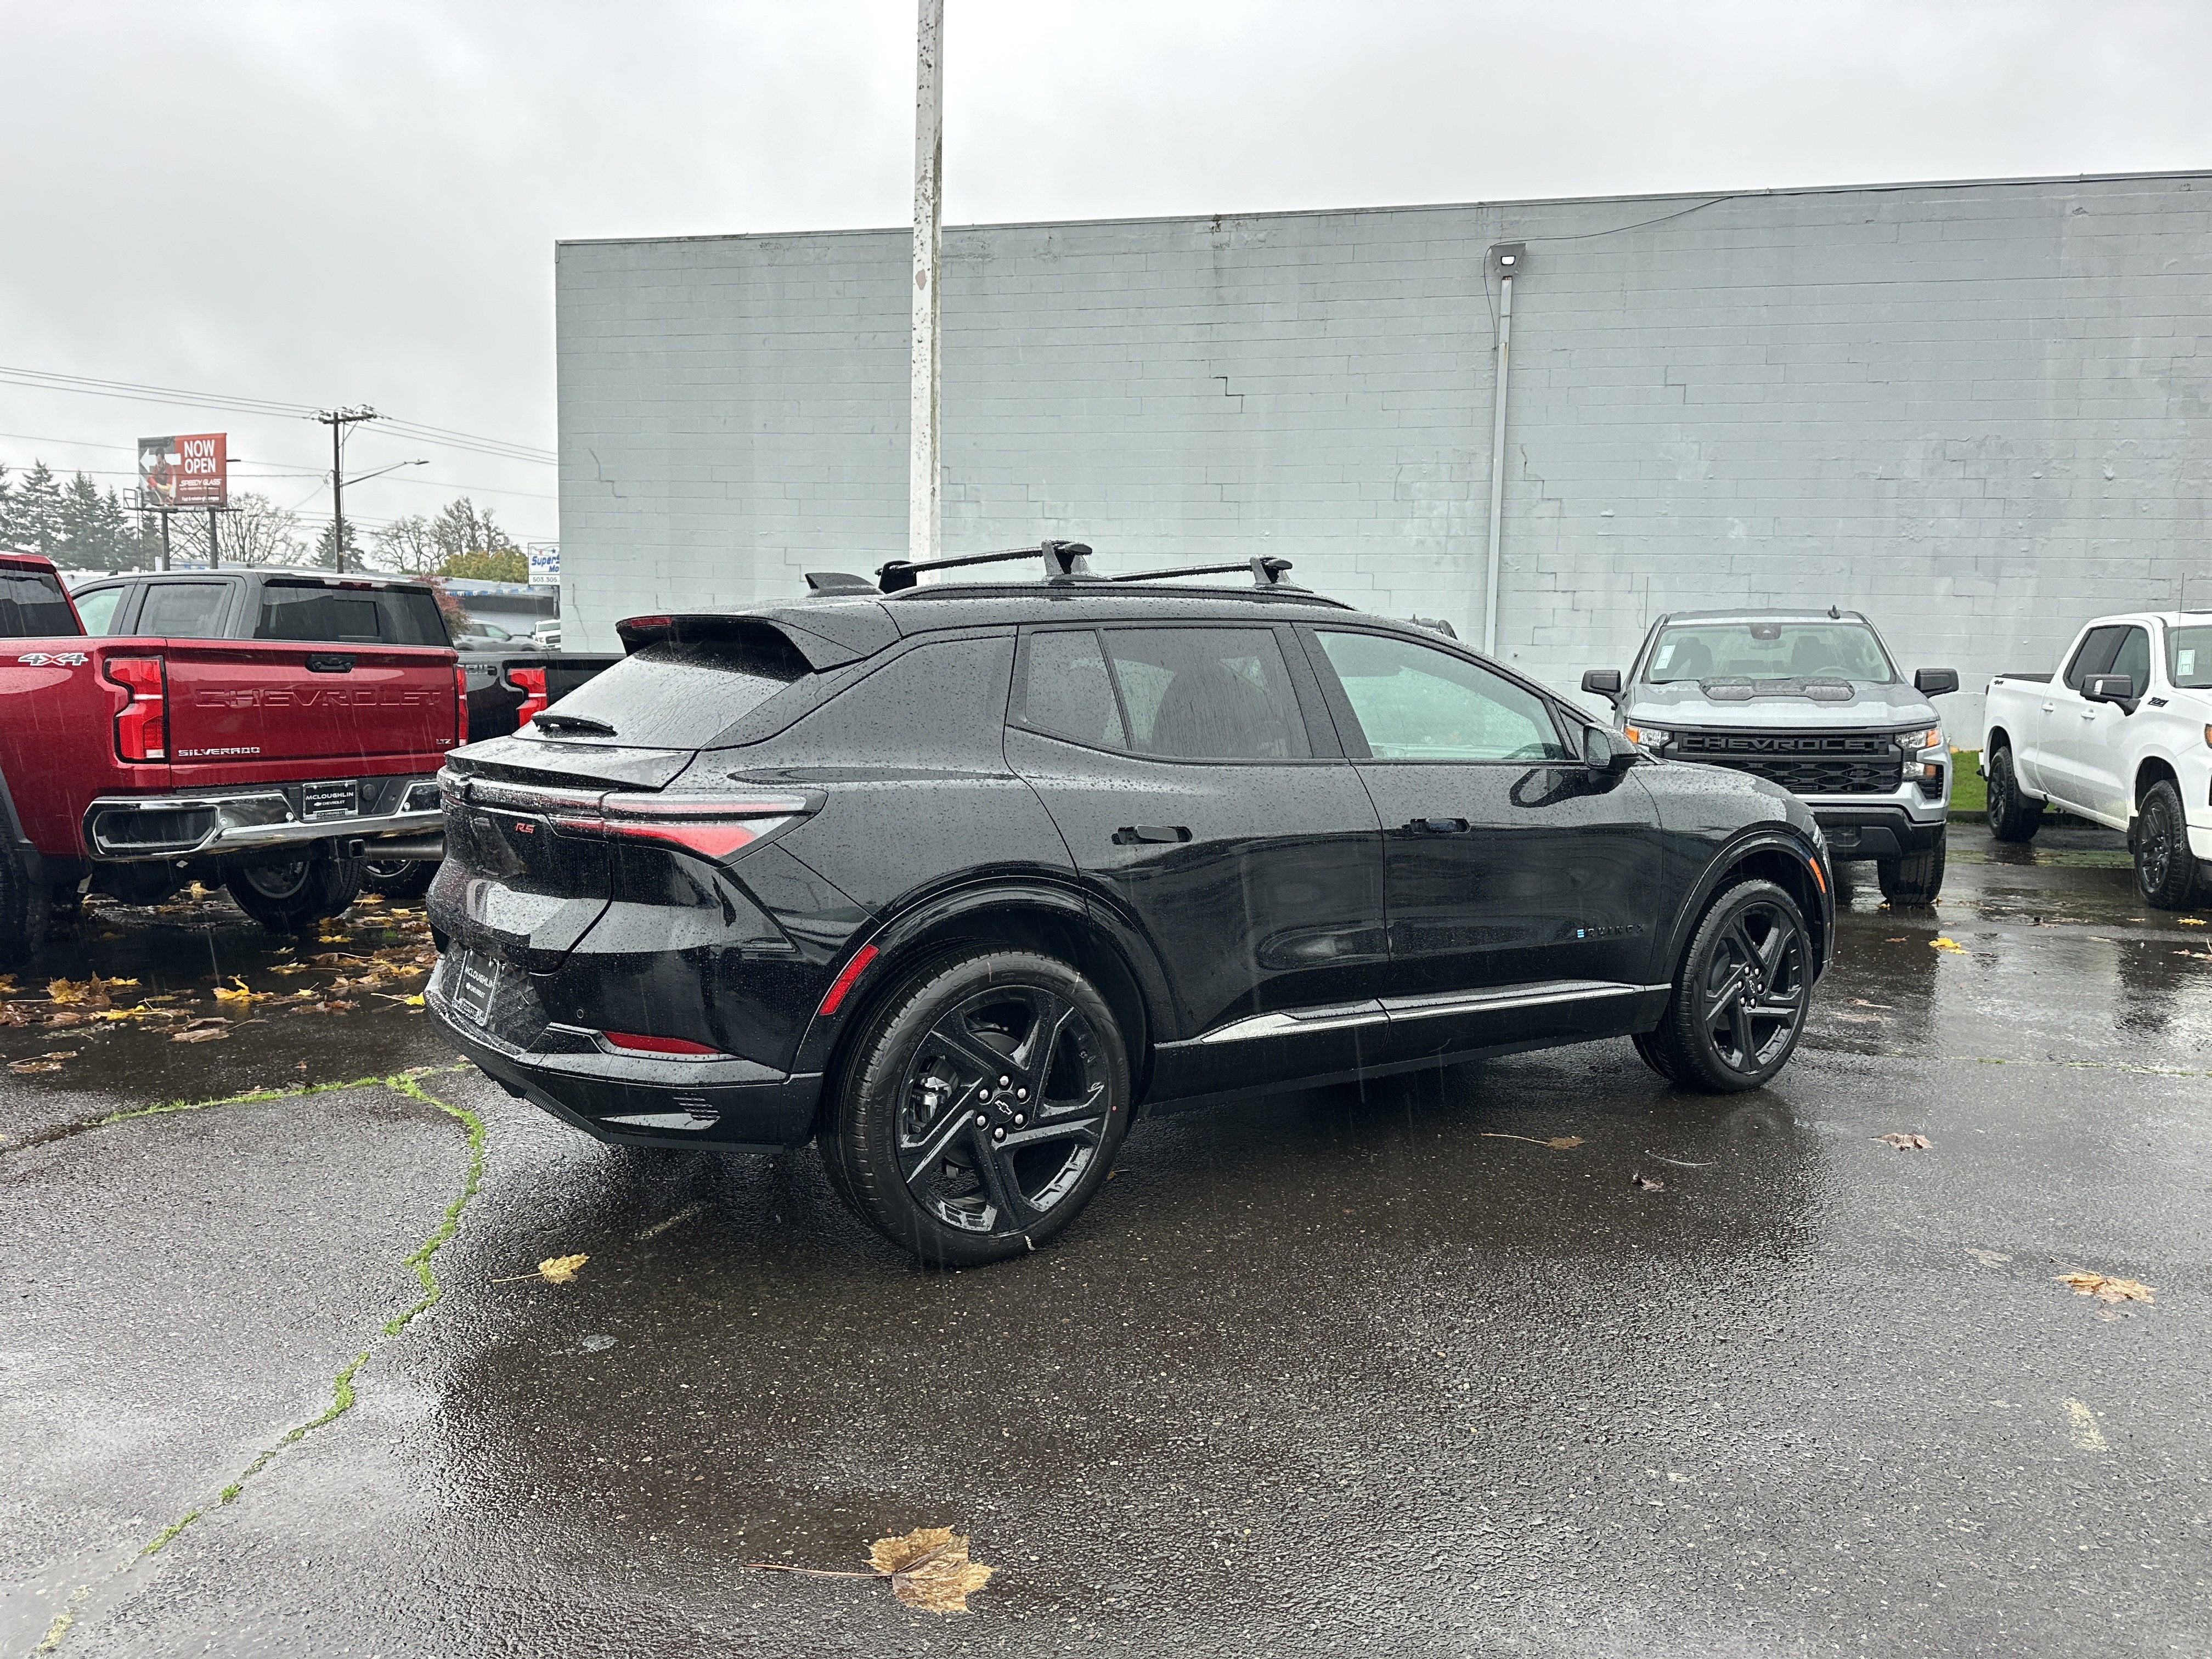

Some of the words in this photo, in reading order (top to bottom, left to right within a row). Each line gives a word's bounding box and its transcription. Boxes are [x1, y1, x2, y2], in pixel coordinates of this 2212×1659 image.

[184, 439, 215, 458] NOW
[184, 458, 216, 473] OPEN
[195, 689, 441, 707] CHEVROLET
[1682, 737, 1886, 751] CHEVROLET
[178, 747, 261, 757] SILVERADO
[306, 791, 354, 800] MCLOUGHLIN
[516, 822, 535, 834] RS
[464, 965, 493, 988] MCLOUGHLIN
